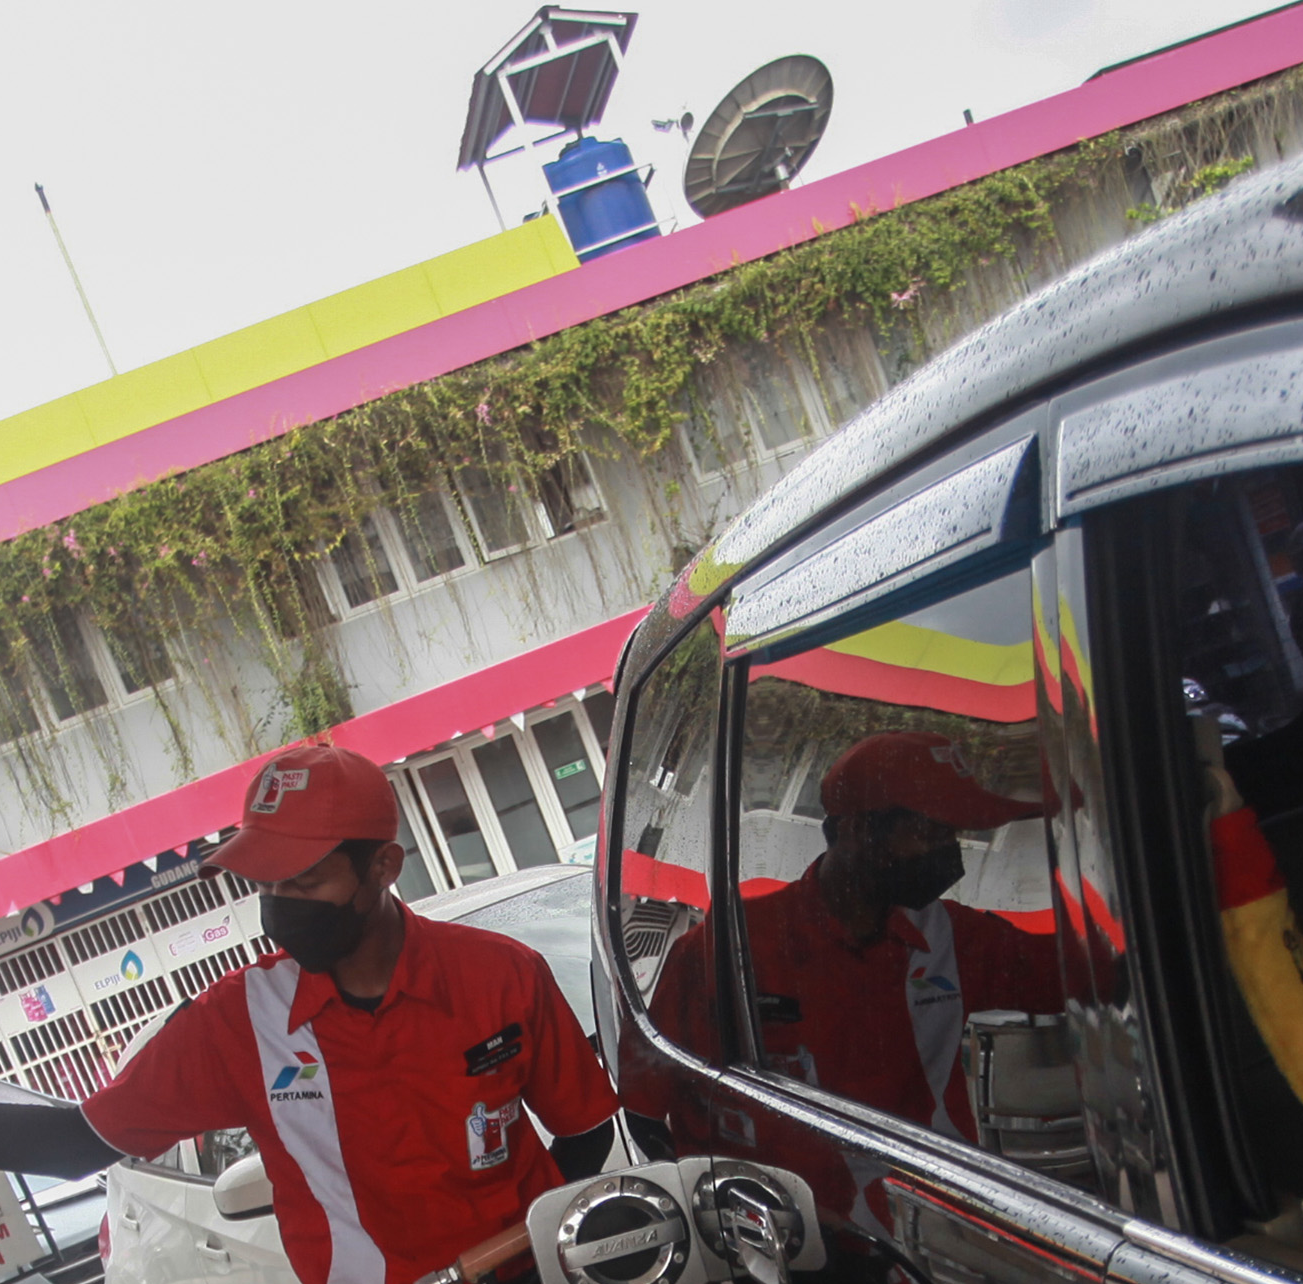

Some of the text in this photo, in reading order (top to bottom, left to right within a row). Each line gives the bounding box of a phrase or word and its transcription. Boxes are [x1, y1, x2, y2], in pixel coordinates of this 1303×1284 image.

[151, 860, 198, 889] GUDANG
[203, 925, 229, 944] Gas
[94, 974, 122, 991] ELPIJI
[270, 1091, 324, 1102] PERTAMINA
[592, 1229, 658, 1259] AVANZA
